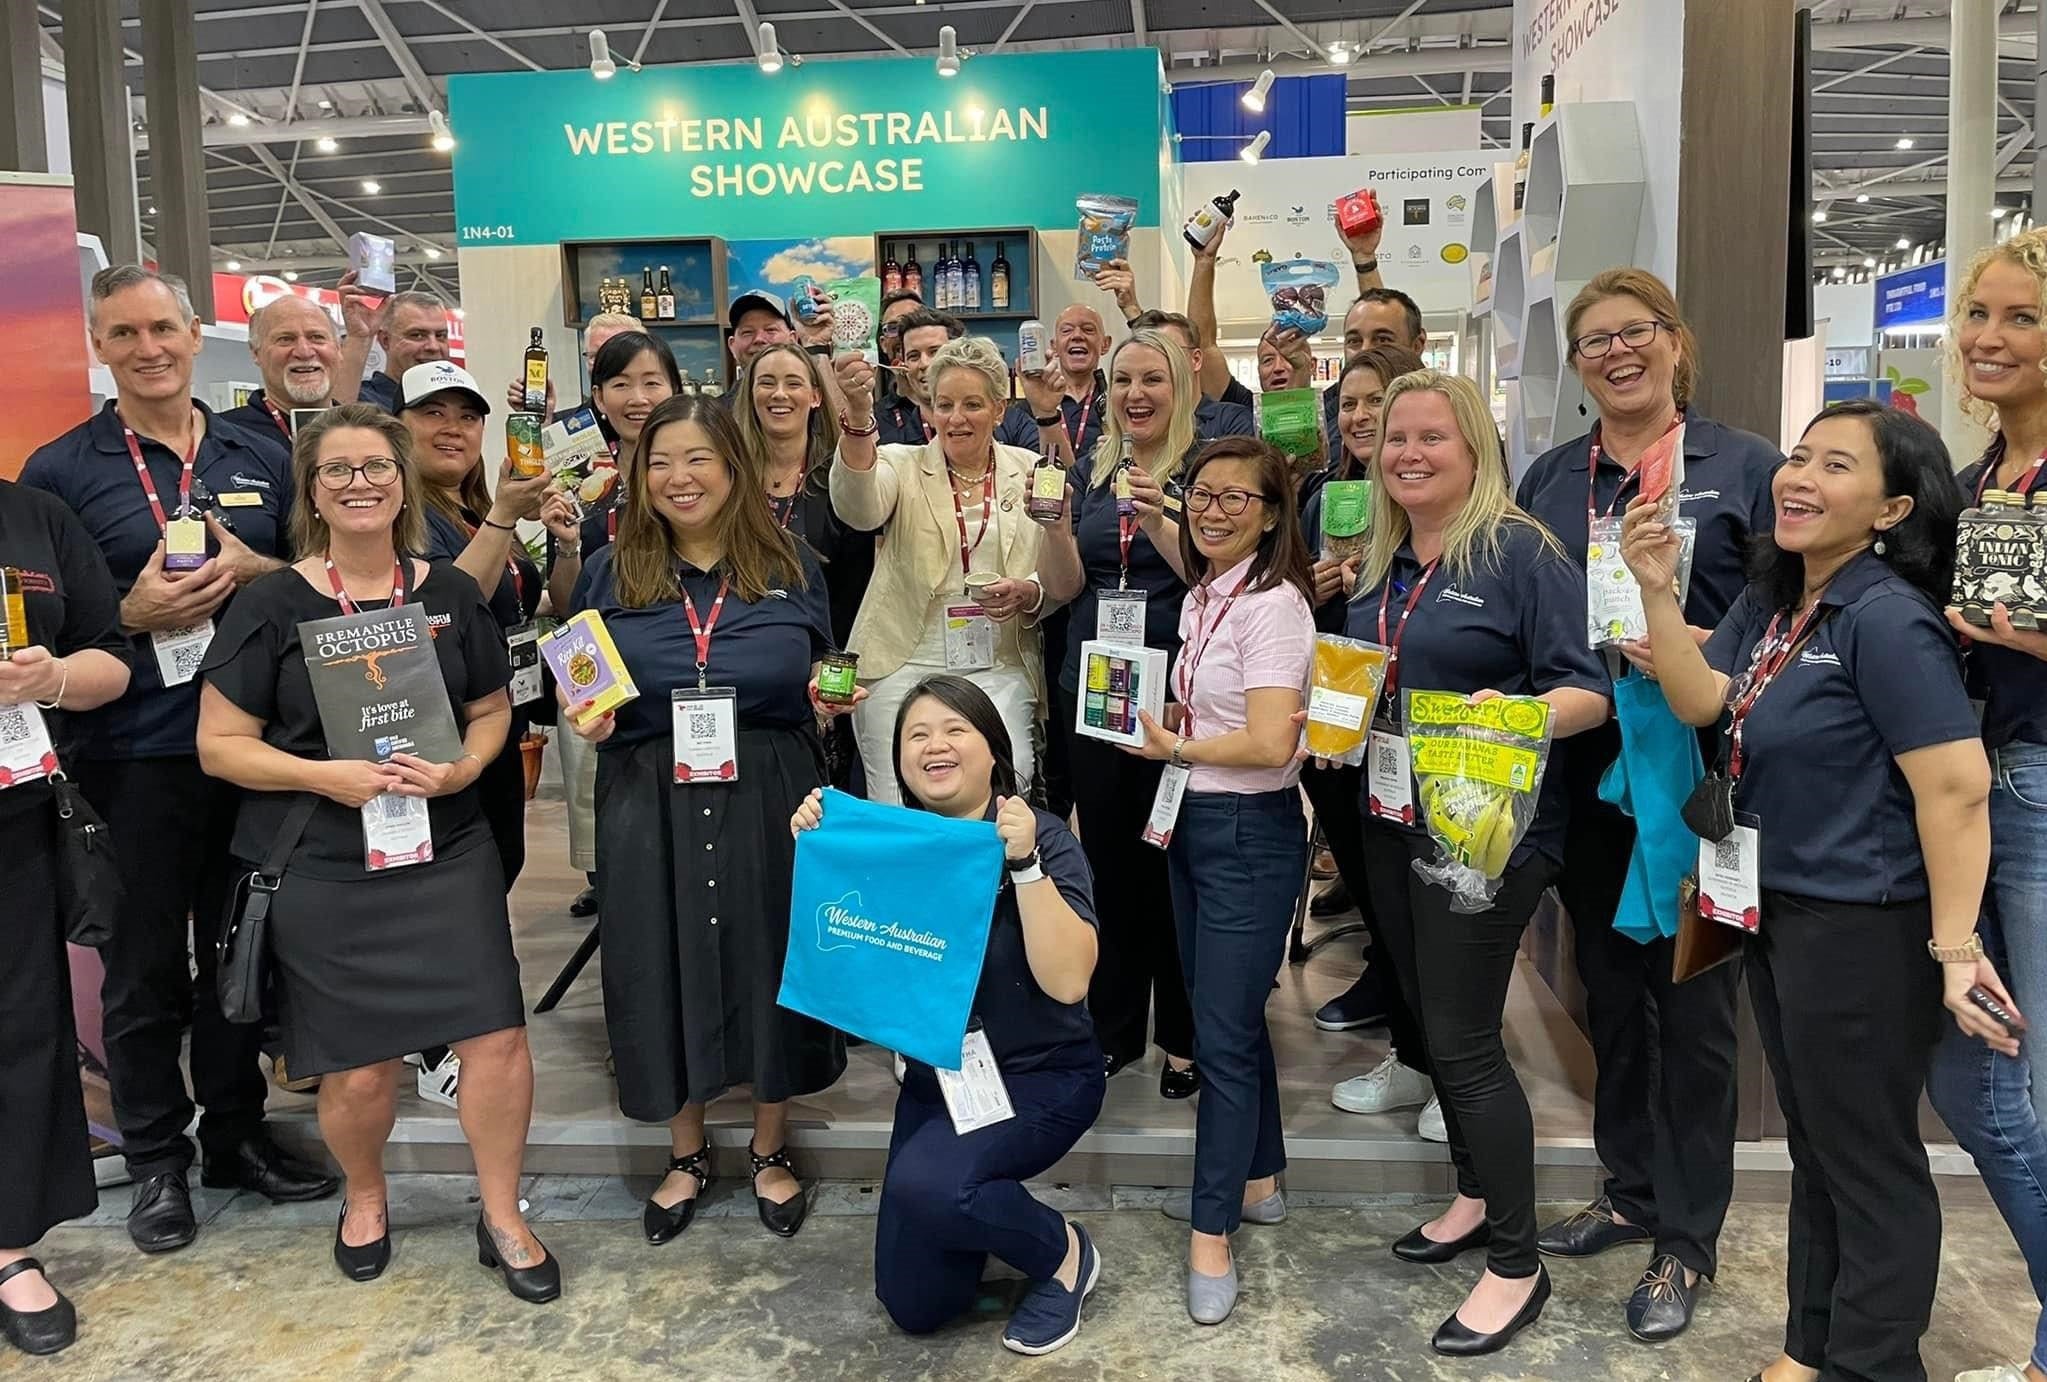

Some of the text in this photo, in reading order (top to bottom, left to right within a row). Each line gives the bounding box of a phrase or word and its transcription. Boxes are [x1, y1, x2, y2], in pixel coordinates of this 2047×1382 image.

[1550, 0, 1619, 74] SHOWCASE
[564, 107, 1048, 155] WESTERN AUSTRALIAN
[690, 158, 924, 198] SHOWCASE
[1368, 166, 1453, 182] Participating
[463, 225, 515, 240] 1N4-01
[1978, 553, 2024, 566] TONIC
[1979, 541, 2031, 554] INDIAN
[316, 618, 414, 644] FREMANTLE
[319, 628, 417, 658] OCTOPUS
[377, 702, 398, 713] love
[399, 699, 409, 708] at
[358, 708, 415, 732] first bite
[1427, 749, 1456, 760] TASTE
[1430, 739, 1498, 756] OUR BANANAS
[824, 906, 947, 950] Western Australian
[827, 926, 943, 962] PREMIUM FOOD AND BEVERAGE
